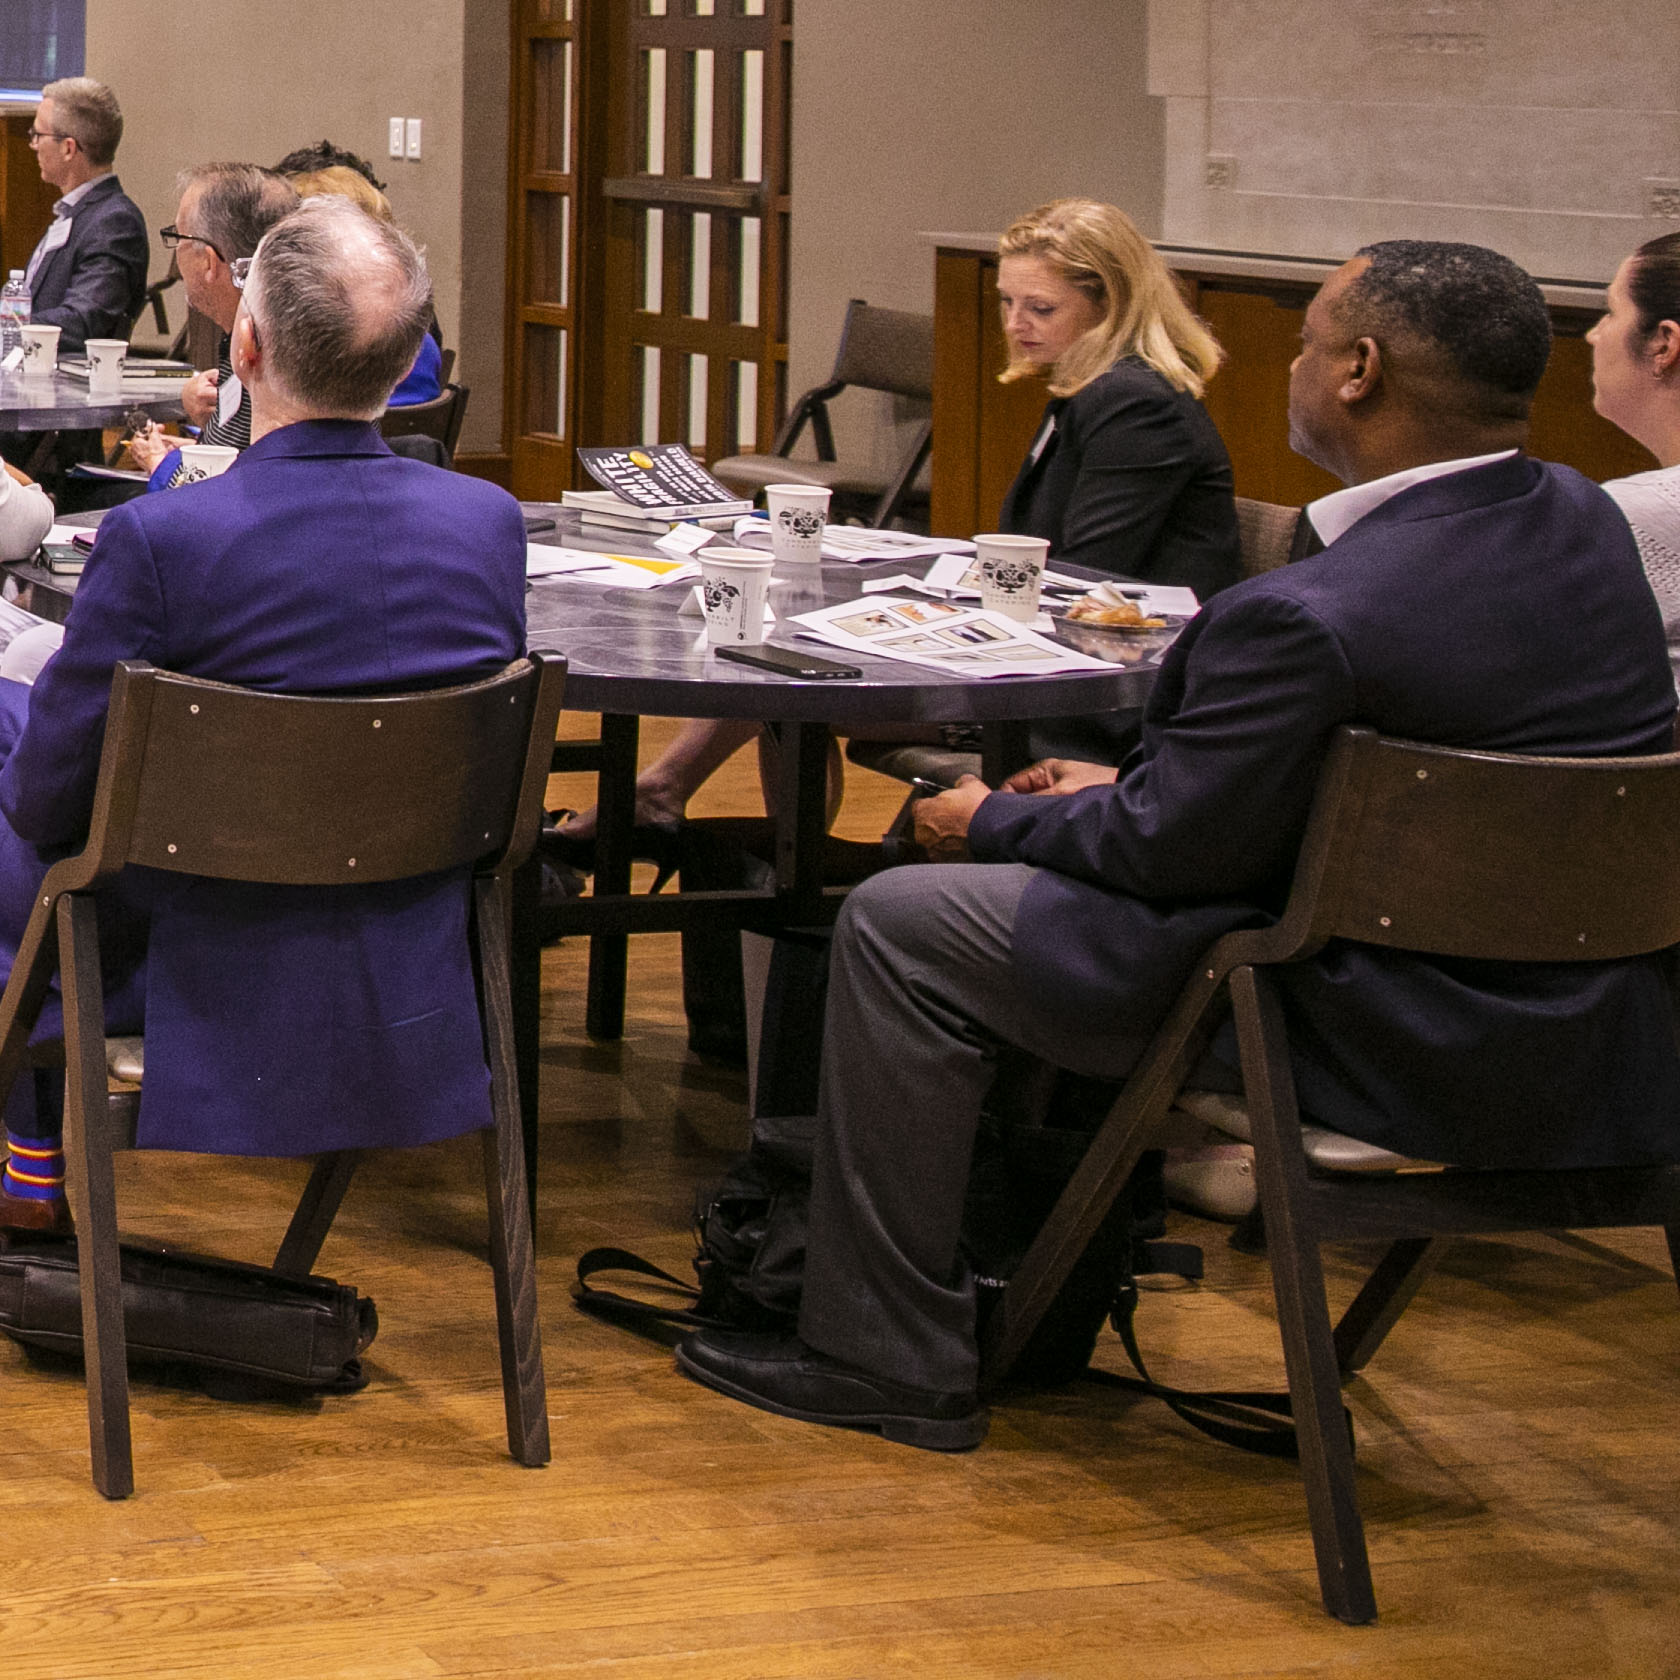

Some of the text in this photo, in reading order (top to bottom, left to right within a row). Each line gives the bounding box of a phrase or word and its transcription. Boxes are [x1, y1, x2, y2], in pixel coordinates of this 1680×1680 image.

[596, 457, 663, 504] WHITE
[613, 453, 684, 504] FRAGILITY
[980, 1276, 997, 1288] Arts
